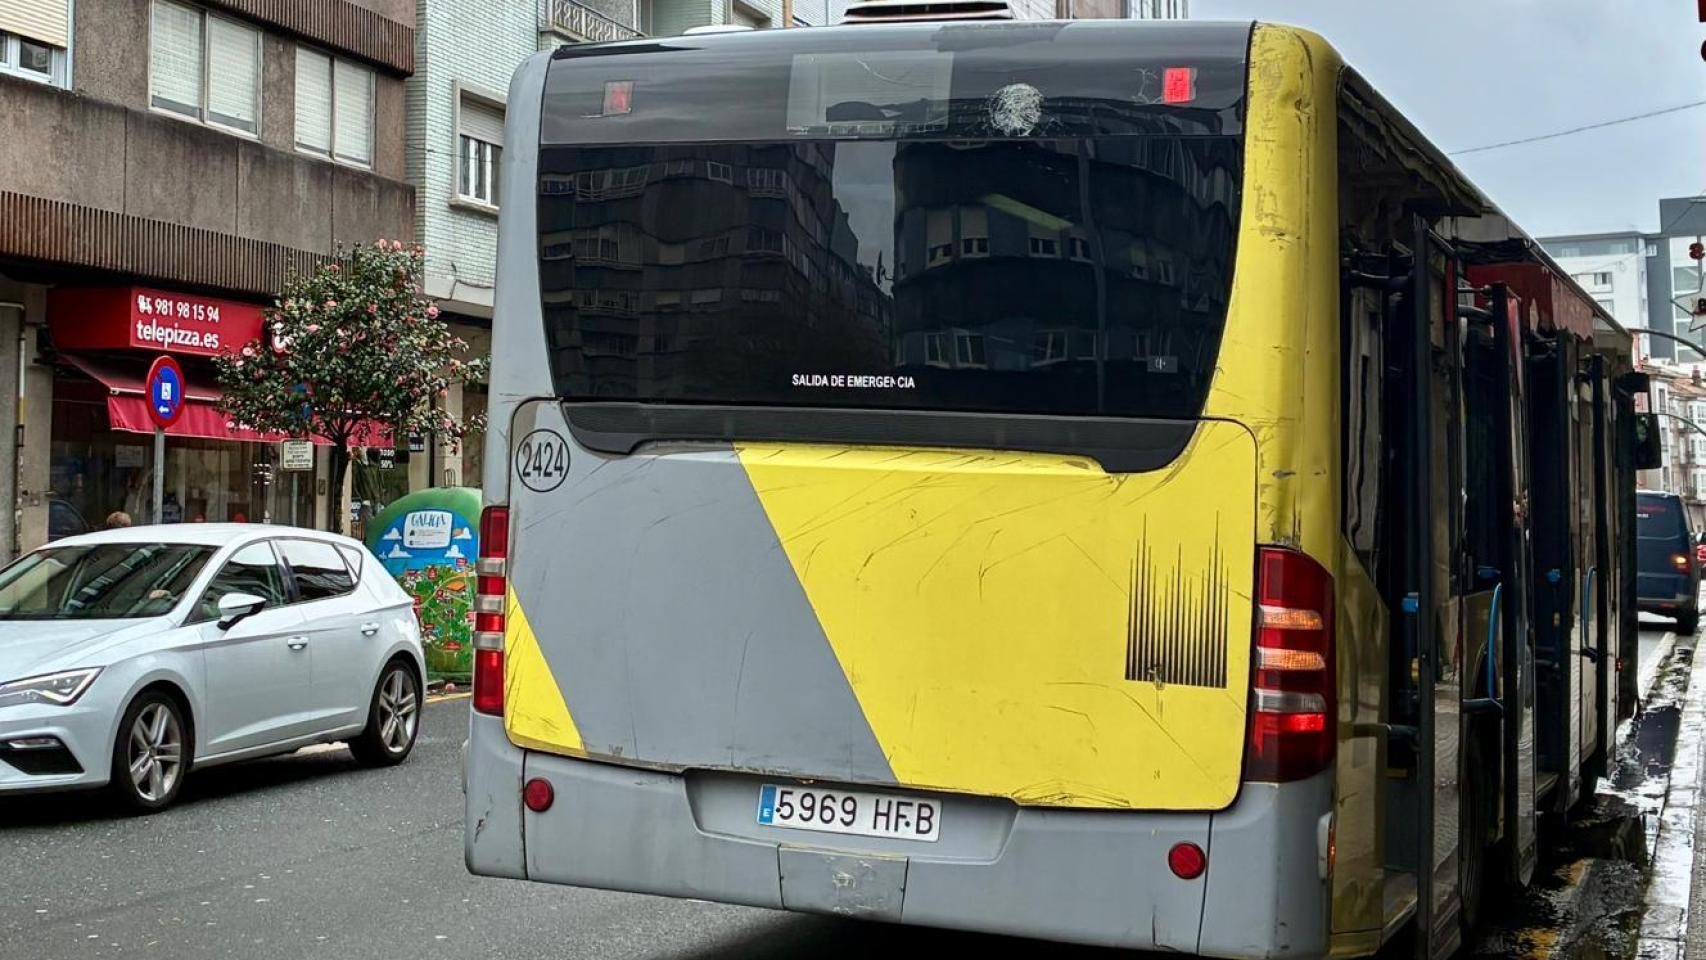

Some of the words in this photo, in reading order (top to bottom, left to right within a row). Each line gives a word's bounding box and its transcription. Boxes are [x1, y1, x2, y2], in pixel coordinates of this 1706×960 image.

[155, 298, 173, 315] 981
[176, 302, 190, 318] 98
[193, 304, 204, 320] 15
[207, 306, 219, 322] 94
[136, 318, 219, 349] telepizza.es
[792, 374, 829, 386] SALIDA
[830, 375, 845, 387] DE
[522, 441, 563, 477] 2424
[763, 807, 771, 817] E
[778, 790, 857, 827] 5969
[872, 798, 935, 835] HFB
